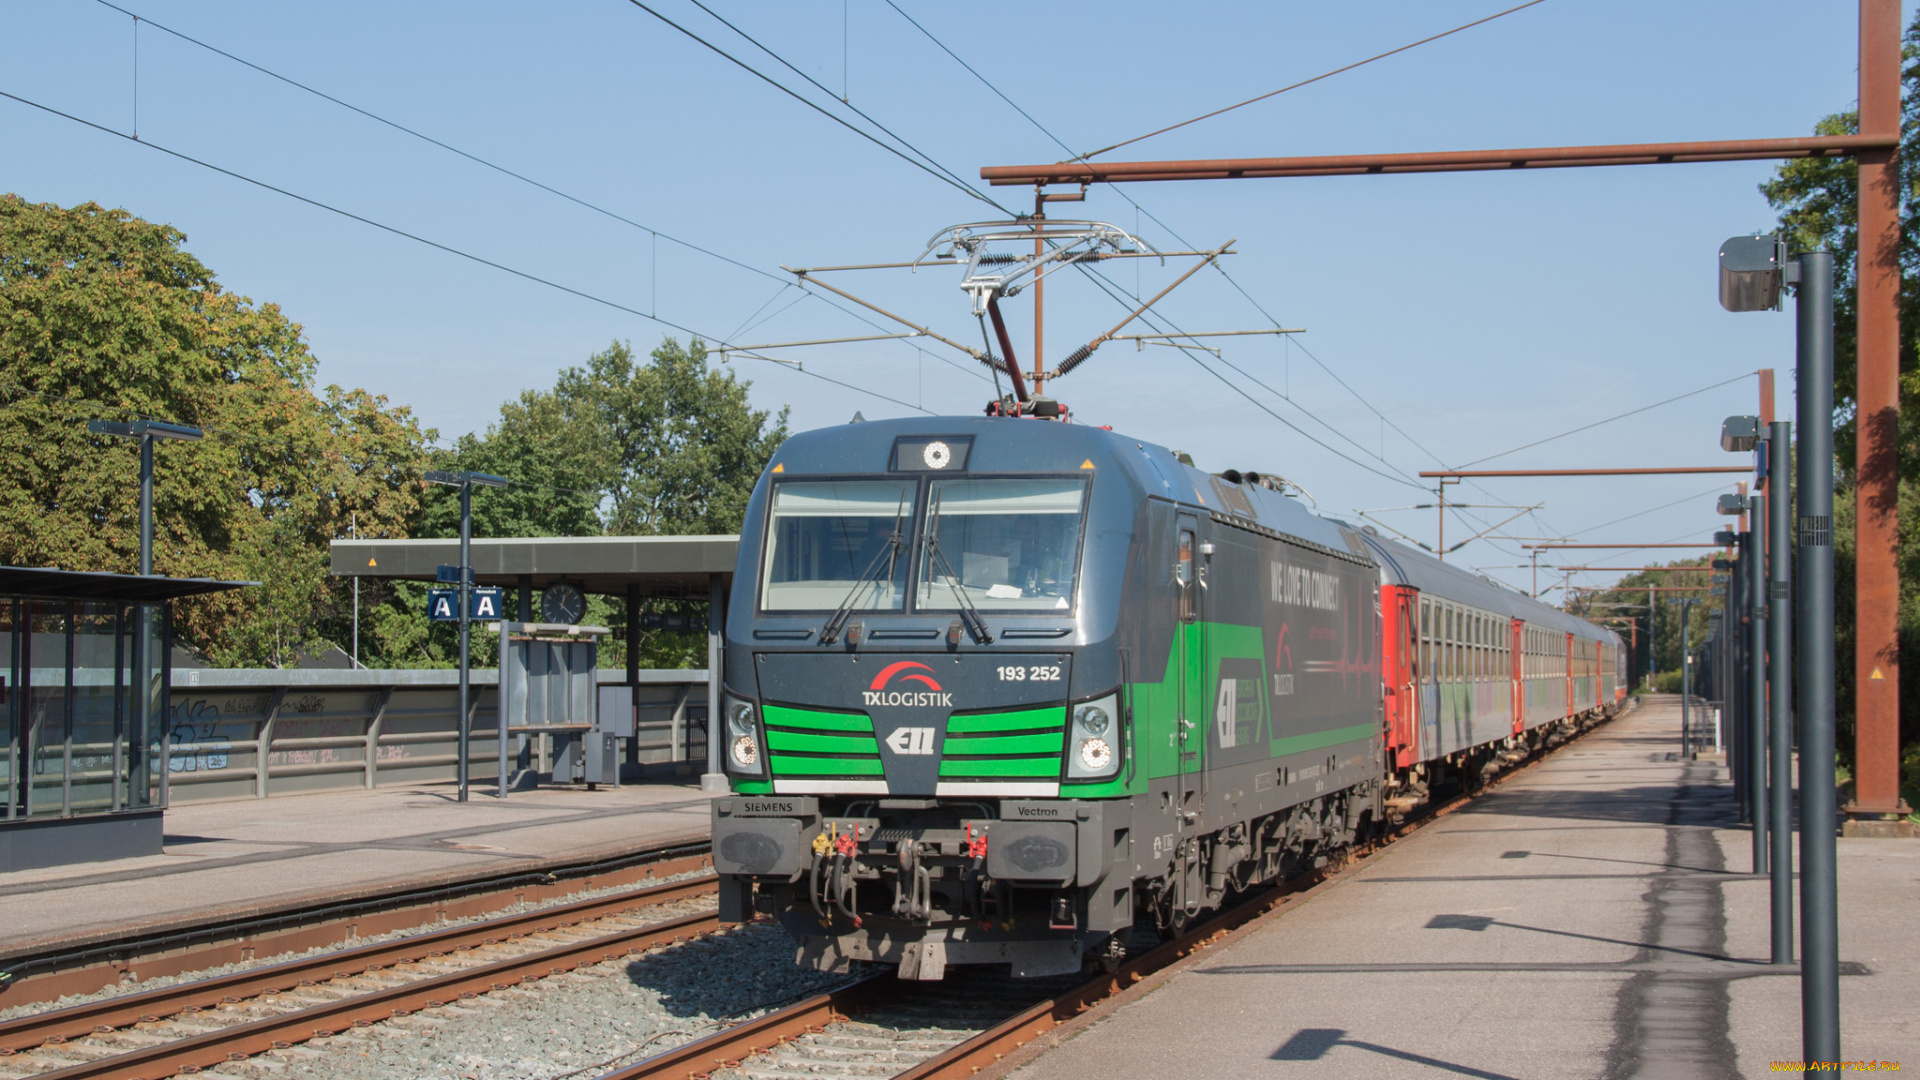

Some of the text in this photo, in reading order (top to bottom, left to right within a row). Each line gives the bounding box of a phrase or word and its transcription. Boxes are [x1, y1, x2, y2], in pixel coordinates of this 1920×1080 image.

[1271, 560, 1339, 611] WE LOVE TO CONNECT
[435, 597, 451, 617] A
[477, 596, 495, 616] A
[997, 666, 1060, 681] 193 252
[862, 691, 953, 707] TXLOGISTIK
[744, 802, 793, 812] SIEMENS
[1018, 806, 1058, 816] Vectron
